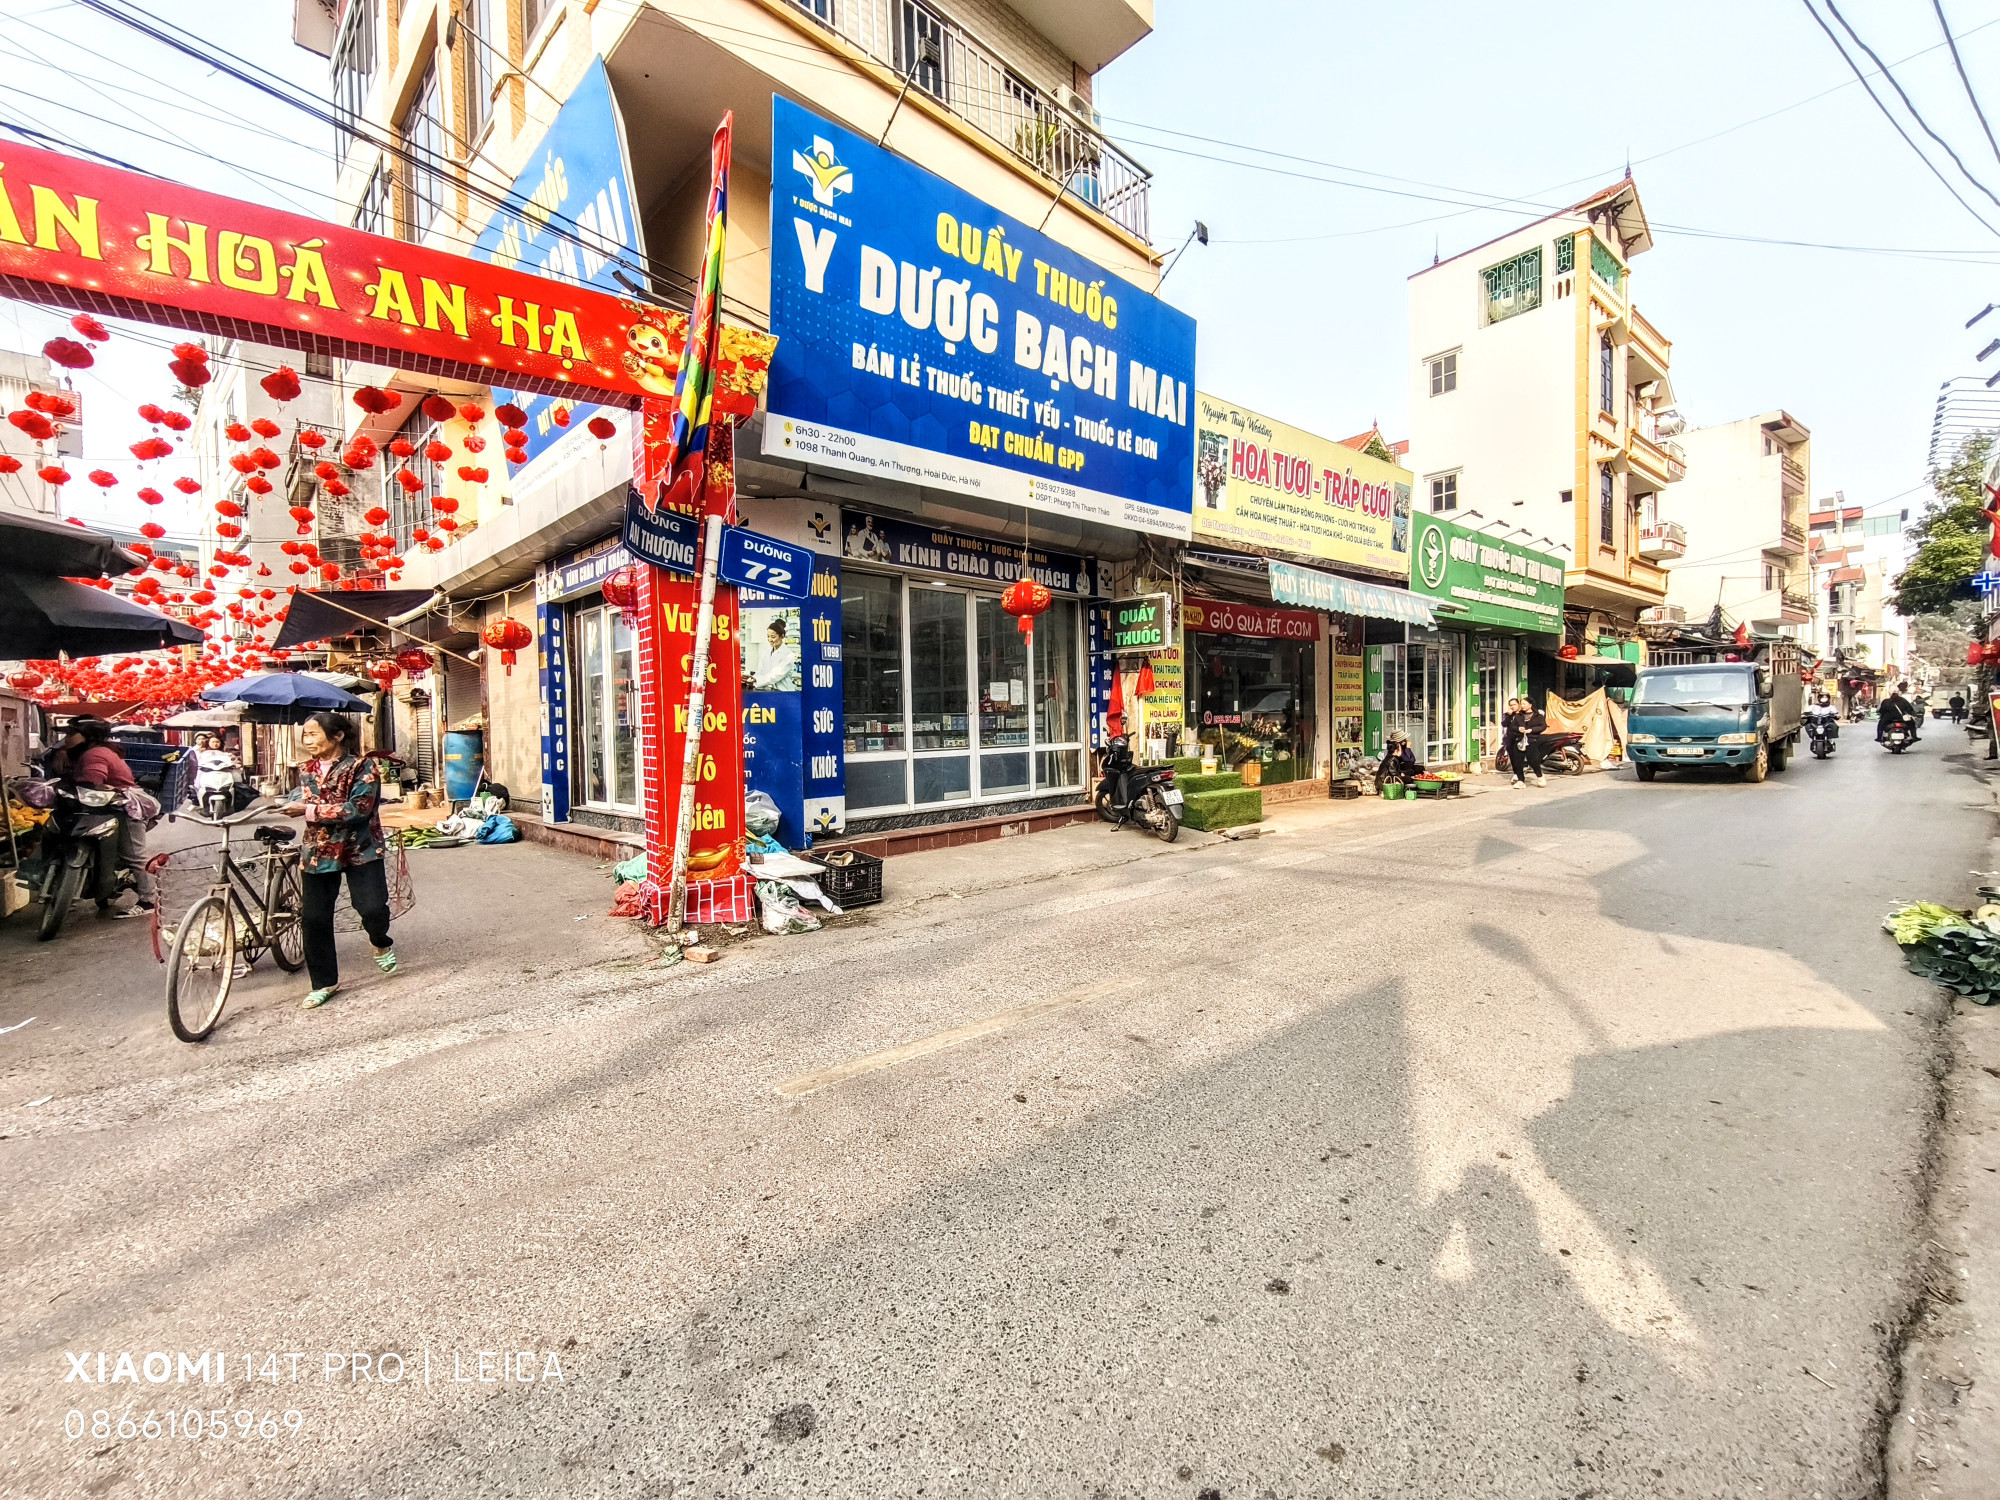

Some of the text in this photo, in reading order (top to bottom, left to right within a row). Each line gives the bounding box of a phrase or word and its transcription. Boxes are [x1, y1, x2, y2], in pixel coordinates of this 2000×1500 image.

[521, 149, 569, 245] THUỐC
[576, 175, 628, 281] MAI
[799, 198, 818, 213] DƯỢC
[819, 206, 838, 223] BẠCH
[838, 213, 852, 228] MAI
[936, 212, 1118, 330] QUẦY THUỐC
[135, 211, 345, 311] HOÁ
[364, 266, 471, 339] AN
[490, 294, 592, 371] HẠ
[793, 216, 1188, 428] Y DƯỢC BẠCH MAI
[851, 342, 895, 380] BÁN
[900, 353, 921, 388] LẺ
[926, 365, 983, 406] THUỐC
[987, 386, 1030, 420] THIẾT
[1033, 399, 1060, 430] YẾU
[1073, 415, 1115, 447] THUỐC
[1117, 428, 1132, 453] KÊ
[1134, 435, 1158, 461] ĐƠN
[795, 426, 857, 447] 6h30 22h00
[1247, 416, 1273, 442] Wedding
[969, 420, 1085, 472] ĐẠT CHUẨN GPP
[795, 440, 981, 488] 1098 Thanh Quang, An Thượng, Hoài Đức, Hà Nội
[1231, 435, 1271, 488] HOA
[1272, 450, 1314, 499] TƯƠI
[1323, 465, 1361, 512] TRÁP
[1361, 476, 1394, 522] CƯỚI
[1036, 481, 1076, 498] 035 927 9388
[1072, 501, 1081, 511] Thị
[1081, 504, 1097, 514] Thanh
[1250, 495, 1274, 509] CHUYÊN
[1274, 499, 1286, 511] LÀM
[1285, 503, 1300, 515] TRÁP
[1300, 506, 1315, 519] RỒNG
[1314, 511, 1335, 525] PHƯỢNG
[1337, 516, 1349, 527] CƯỚI
[1357, 522, 1369, 533] TRỌN
[1236, 506, 1249, 519] CẮM
[1249, 511, 1262, 522] HOA
[1262, 514, 1279, 526] NGHỆ
[1278, 517, 1297, 530] THUẬT
[1299, 523, 1311, 533] HOA
[1310, 524, 1323, 535] TƯƠI
[1322, 527, 1333, 538] HOA
[1354, 534, 1363, 545] QUÀ
[629, 520, 641, 546] AN
[641, 528, 694, 566] THƯỢNG
[743, 539, 792, 563] ĐƯỜNG
[931, 532, 1048, 564] QUẦY THUỐC Y DƯỢC MAI
[566, 568, 579, 588] KÍNH
[580, 561, 595, 583] CHÀO
[607, 548, 630, 572] KHÁCH
[741, 558, 792, 590] 72
[900, 543, 1070, 590] KÍNH CHÀO QUÝ KHÁCH
[812, 612, 832, 644] TỐT
[1119, 601, 1156, 626] QUẦY
[1209, 606, 1312, 637] GIỎ QUÀ TẾT .COM
[1114, 623, 1162, 647] THUỐC
[824, 646, 840, 659] 1098
[1164, 648, 1179, 660] TƯƠI
[812, 664, 834, 689] CHO
[1153, 664, 1165, 674] KHAI
[1155, 679, 1168, 688] CHÚC
[1144, 695, 1158, 704] HOA
[1149, 710, 1162, 718] HOA
[813, 706, 835, 734] SỨC
[811, 750, 838, 780] KHỎE
